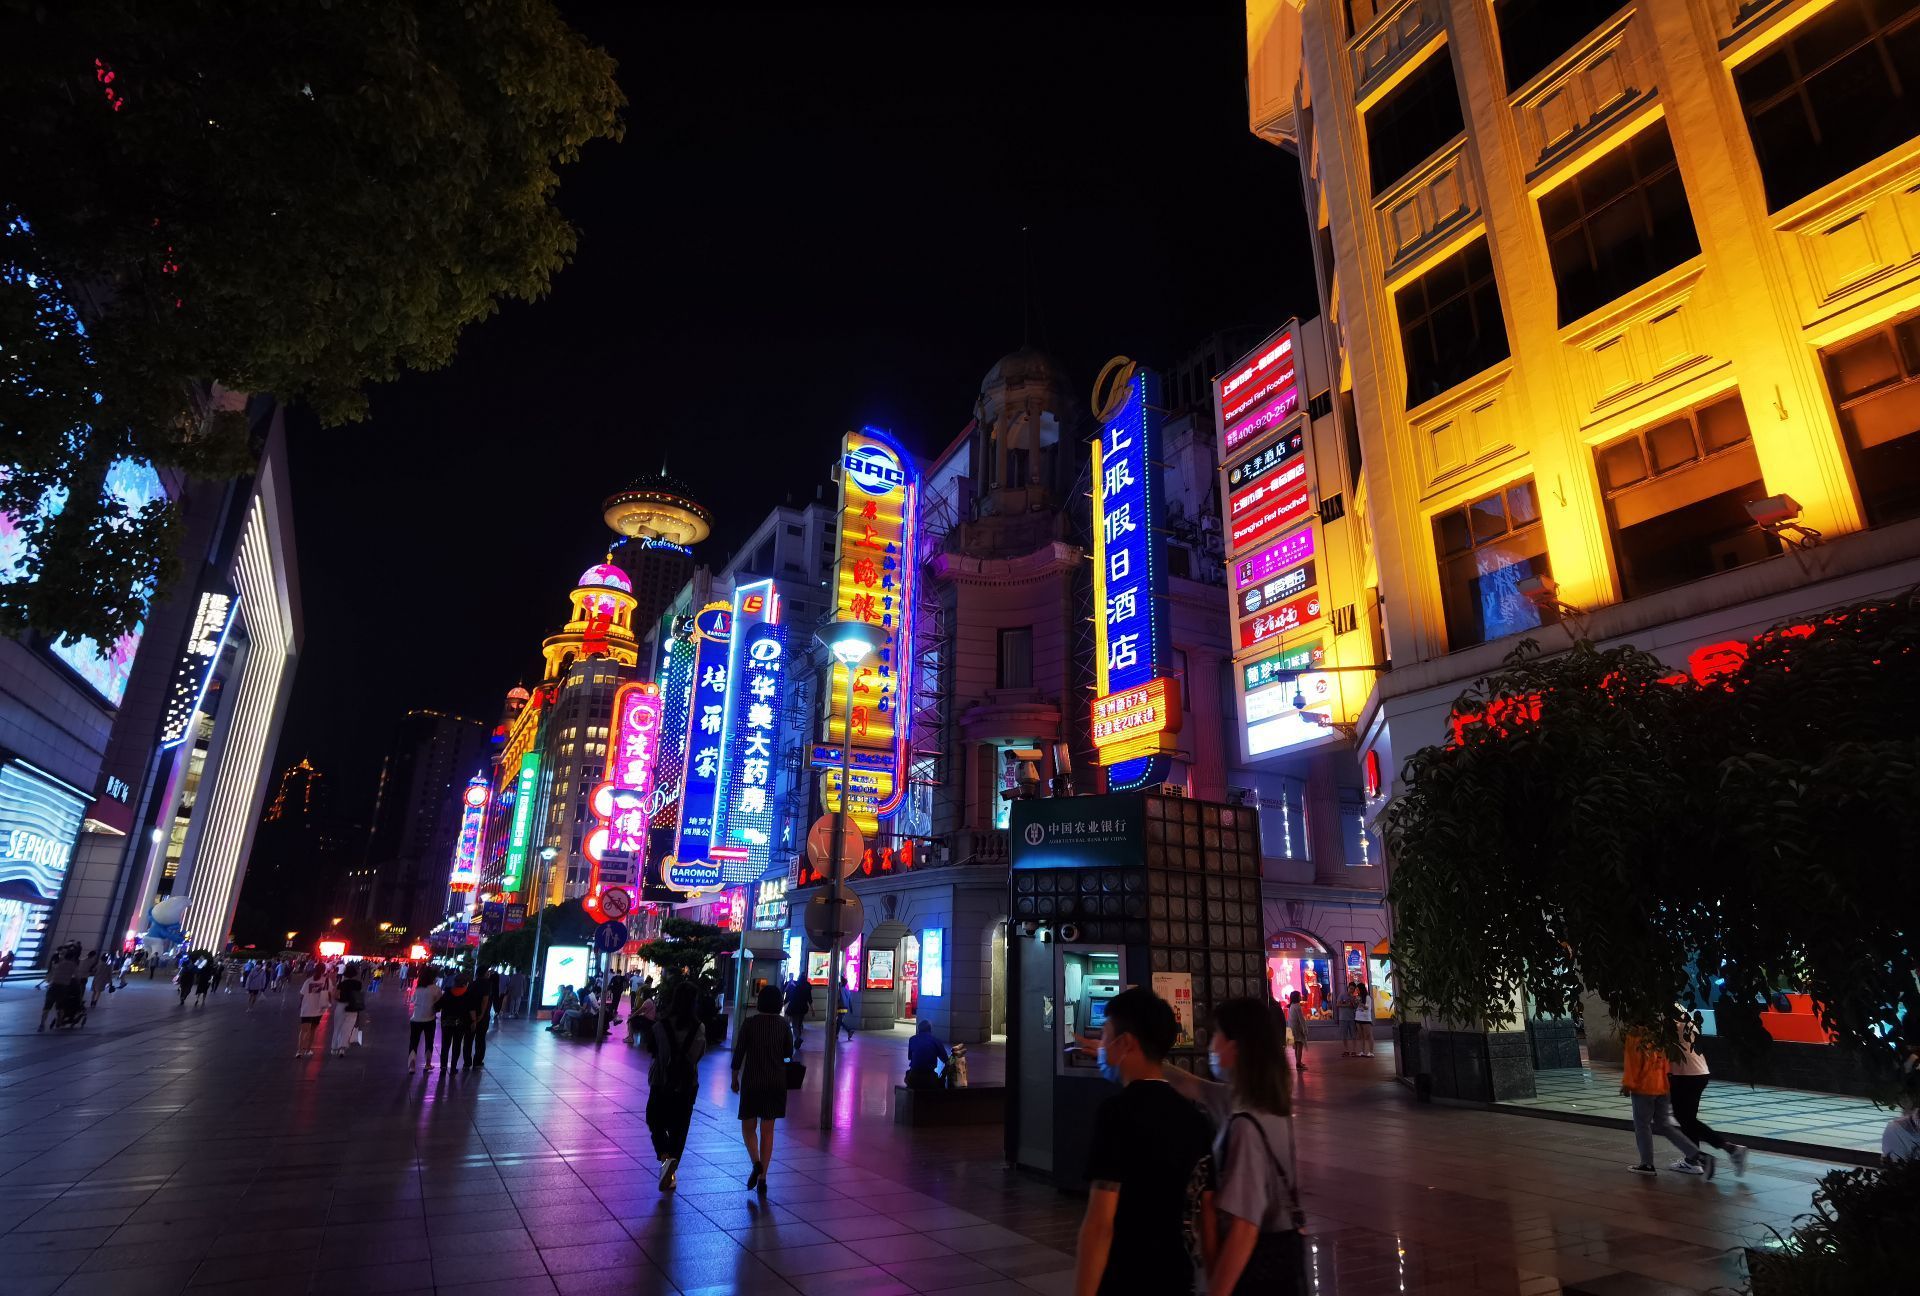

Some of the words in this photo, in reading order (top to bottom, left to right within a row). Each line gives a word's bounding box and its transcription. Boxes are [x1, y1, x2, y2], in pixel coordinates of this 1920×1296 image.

[1225, 396, 1253, 420] Shanghai
[1254, 388, 1267, 401] First
[1266, 368, 1295, 393] Foodhall
[844, 455, 904, 486] BAC
[1233, 517, 1264, 540] Shanghai
[1264, 510, 1277, 524] First
[1277, 494, 1307, 516] Foodhall
[641, 535, 684, 552] Radisson
[1101, 428, 1138, 670] 上服假日酒店
[196, 593, 230, 657] 世茂广场
[724, 732, 735, 764] No.1
[739, 675, 777, 813] 华美大药房
[612, 733, 650, 851] 茂昌镜公
[717, 770, 732, 837] Pharmacy
[5, 829, 69, 869] SEPHORA
[1048, 819, 1127, 835] 中国农业银行
[671, 868, 719, 878] BAROMON
